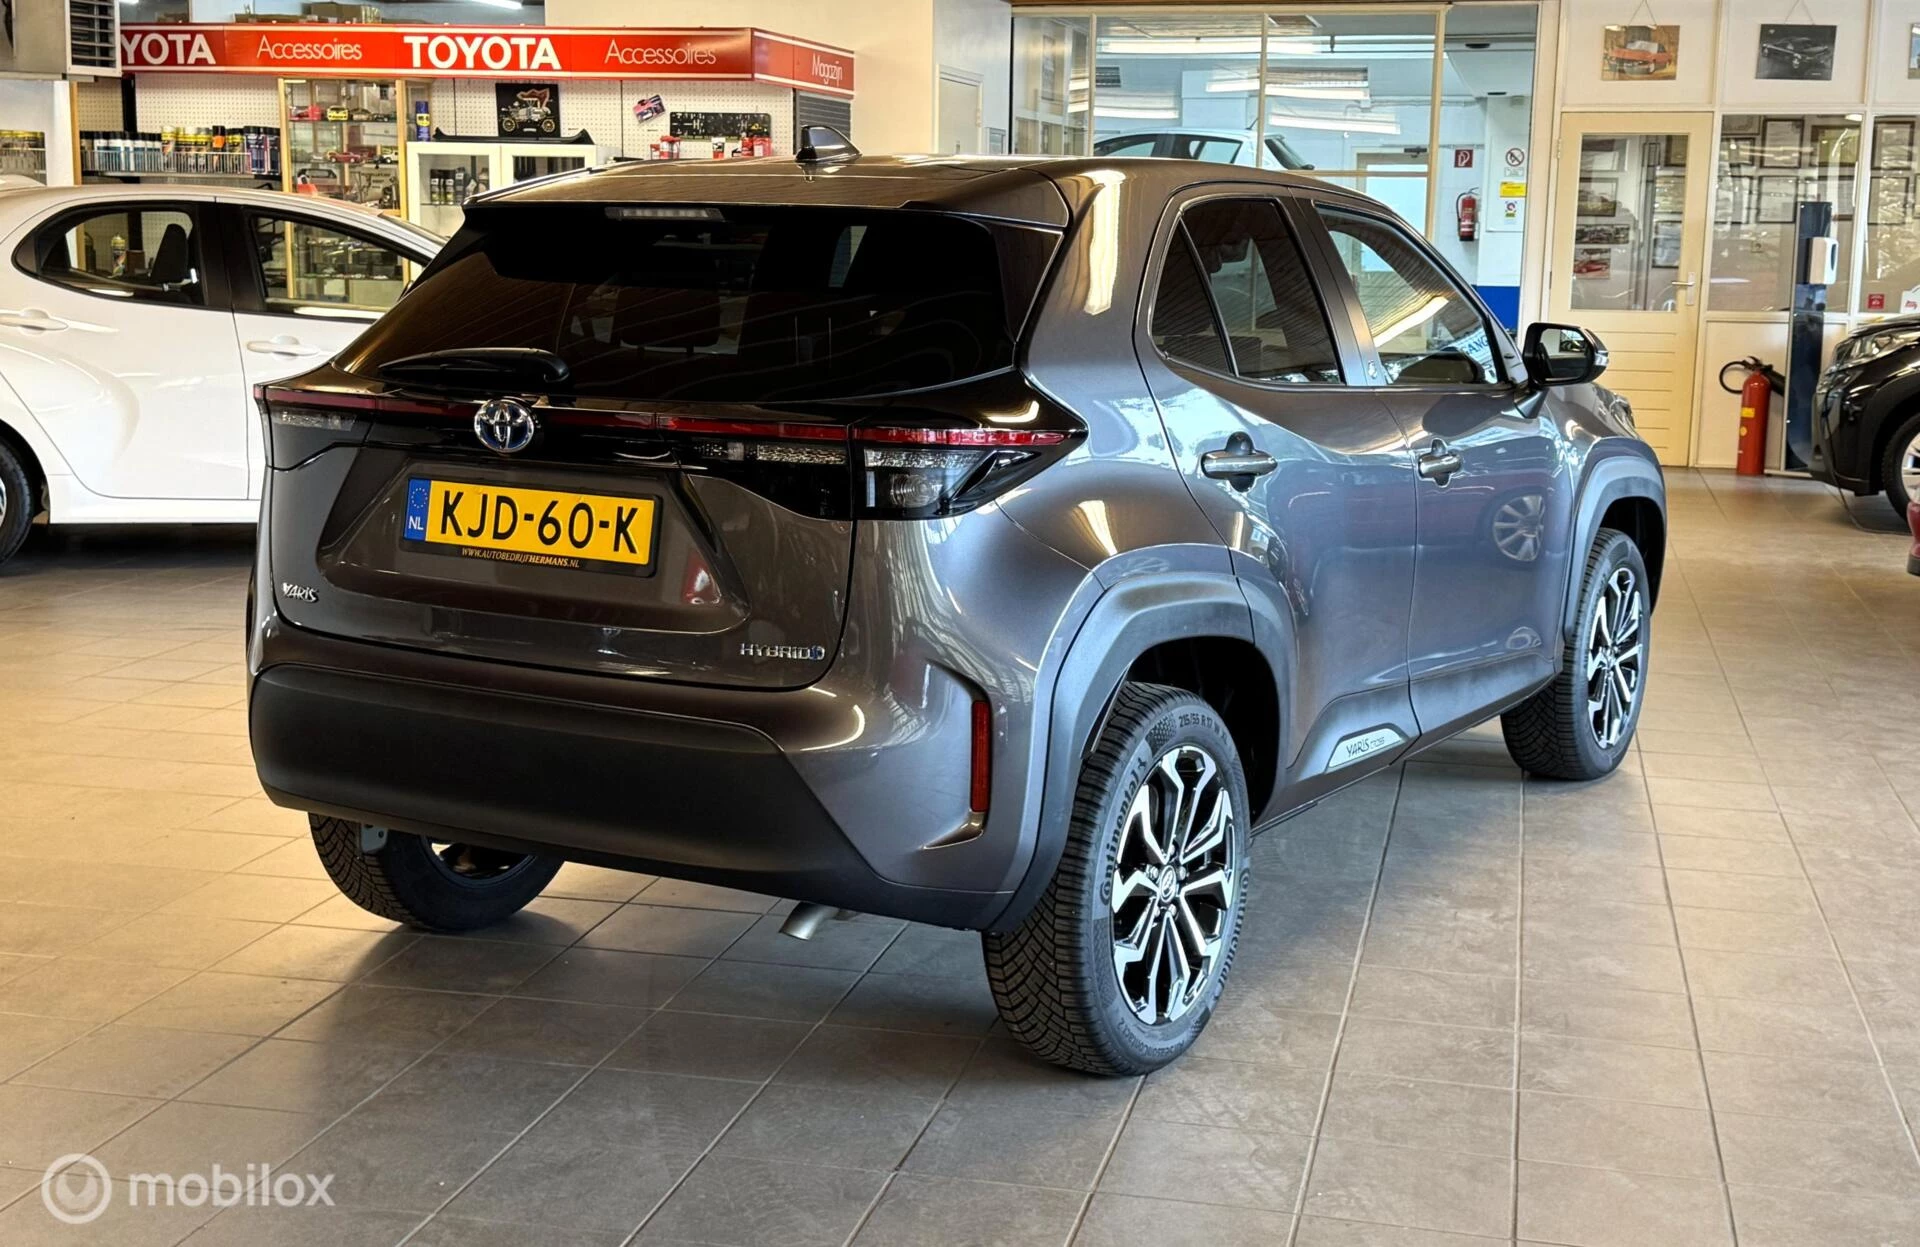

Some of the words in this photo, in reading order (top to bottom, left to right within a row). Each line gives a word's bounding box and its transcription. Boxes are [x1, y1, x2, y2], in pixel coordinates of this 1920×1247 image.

[256, 34, 362, 60] Accessoires
[403, 35, 562, 70] TOYOTA
[604, 39, 716, 65] Accessoires
[408, 516, 424, 531] NL
[440, 490, 638, 554] KJD-60-K
[461, 547, 580, 568] WWW.AUTOBEDRIJFHERMANS.NL
[282, 582, 317, 602] YARIS
[740, 643, 811, 660] HYBRID
[1345, 738, 1370, 757] YARIS
